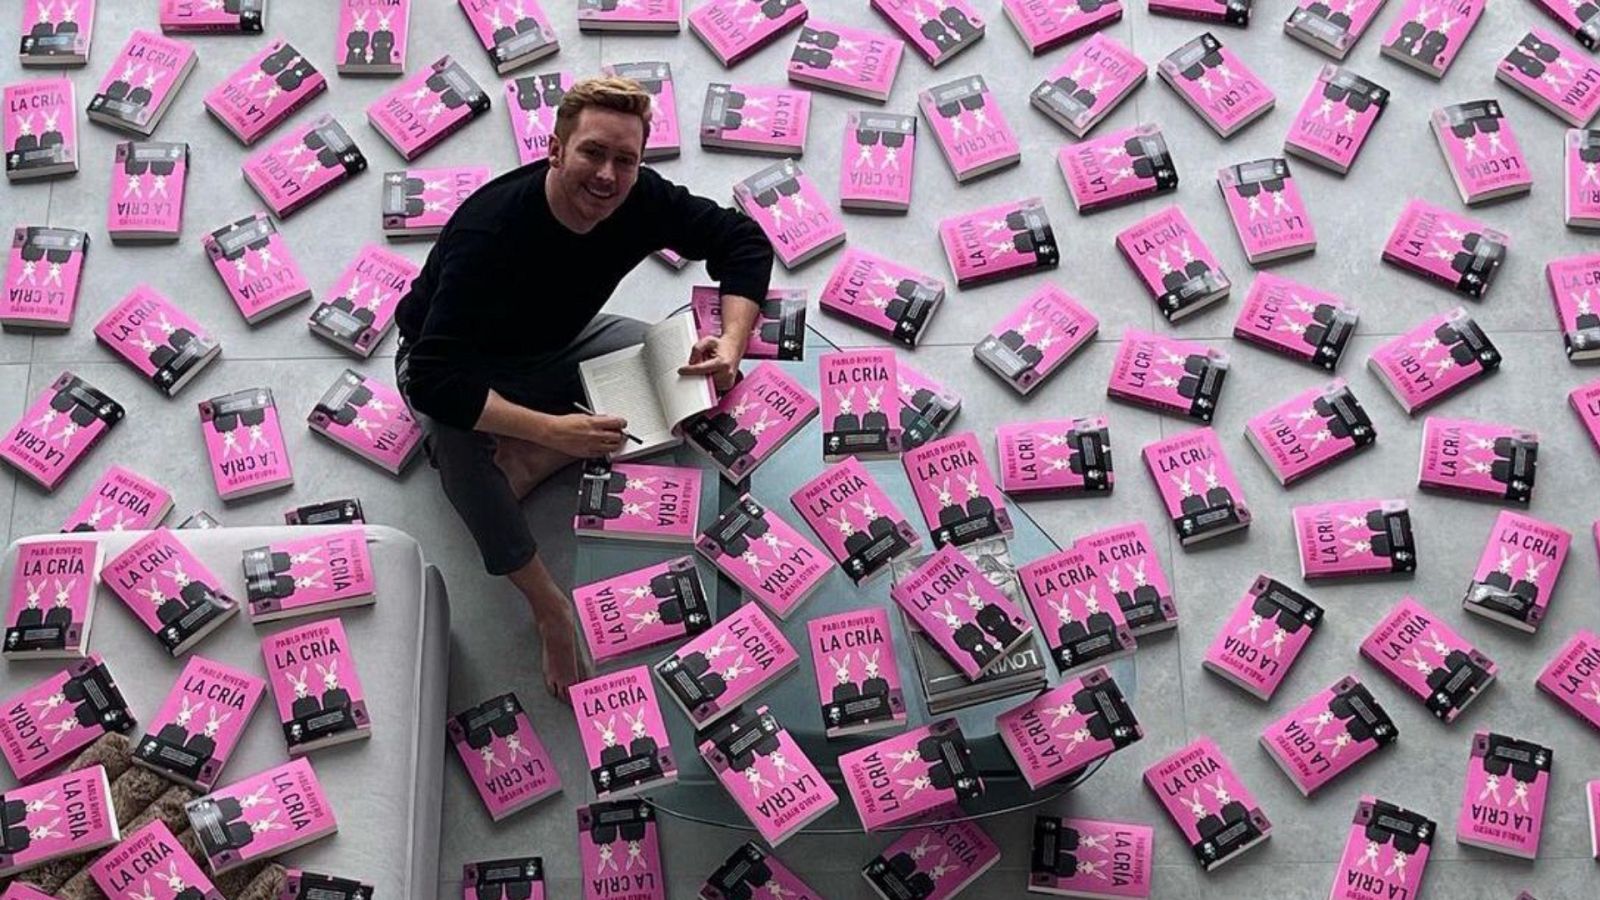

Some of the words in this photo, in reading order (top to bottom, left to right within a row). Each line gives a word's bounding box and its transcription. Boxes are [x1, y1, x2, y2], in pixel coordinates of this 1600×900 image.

[127, 44, 145, 59] LA
[11, 98, 28, 112] LA
[1335, 133, 1353, 150] LA
[282, 178, 301, 196] LA
[1090, 176, 1108, 194] LA
[1133, 239, 1155, 256] LA
[969, 250, 987, 268] LA
[839, 289, 859, 305] LA
[111, 325, 133, 342] LA
[1255, 315, 1275, 331] LA
[832, 358, 855, 366] PABLO
[857, 356, 883, 364] RIVERO
[828, 369, 848, 385] LA
[852, 363, 889, 383] CRÍA
[1128, 373, 1147, 388] LA
[765, 391, 797, 421] CRÍA
[14, 427, 46, 454] CRÍA
[917, 448, 940, 461] PABLO
[940, 440, 967, 453] RIVERO
[45, 447, 65, 466] LA
[917, 462, 940, 481] LA
[940, 448, 979, 472] CRÍA
[1158, 456, 1180, 473] LA
[1289, 444, 1309, 464] LA
[1021, 464, 1038, 481] LA
[1440, 461, 1457, 477] LA
[805, 482, 827, 499] PABLO
[826, 467, 850, 485] RIVERO
[99, 482, 119, 500] LA
[118, 492, 150, 517] CRÍA
[809, 498, 833, 517] LA
[830, 475, 868, 503] CRÍA
[657, 494, 679, 526] CRÍA
[30, 548, 54, 556] PABLO
[56, 547, 82, 555] RIVERO
[789, 546, 813, 566] LA
[1110, 539, 1147, 561] CRÍA
[1321, 546, 1339, 563] LA
[23, 560, 42, 576] LA
[47, 555, 83, 575] CRÍA
[800, 562, 820, 581] PABLO
[907, 574, 928, 594] PABLO
[926, 556, 950, 577] RIVERO
[1033, 563, 1057, 577] PABLO
[1057, 554, 1084, 568] RIVERO
[118, 570, 143, 590] LA
[760, 563, 796, 593] CRÍA
[780, 579, 802, 599] RIVERO
[912, 591, 937, 612] LA
[932, 564, 970, 595] CRÍA
[1034, 578, 1058, 597] LA
[1058, 563, 1098, 588] CRÍA
[584, 597, 598, 622] RIVERO
[594, 586, 621, 622] CRÍA
[592, 622, 606, 644] PABLO
[608, 623, 628, 644] LA
[748, 614, 767, 633] PABLO
[764, 632, 784, 654] RIVERO
[822, 621, 846, 632] PABLO
[847, 616, 875, 627] RIVERO
[1375, 627, 1393, 645] PABLO
[1390, 609, 1411, 629] RIVERO
[275, 635, 300, 648] PABLO
[301, 627, 330, 640] RIVERO
[727, 618, 750, 640] LA
[743, 636, 775, 670] CRÍA
[820, 635, 842, 653] LA
[845, 625, 884, 648] CRÍA
[1225, 634, 1258, 663] CRÍA
[1382, 642, 1405, 661] LA
[1397, 615, 1431, 644] CRÍA
[274, 650, 298, 669] LA
[300, 636, 341, 661] CRÍA
[1259, 655, 1280, 675] LA
[198, 665, 223, 679] PABLO
[222, 674, 249, 689] RIVERO
[584, 683, 608, 696] PABLO
[609, 675, 637, 689] RIVERO
[183, 675, 205, 695] LA
[207, 684, 245, 710] CRÍA
[583, 698, 606, 718] LA
[608, 684, 648, 710] CRÍA
[8, 702, 37, 739] CRÍA
[1020, 708, 1050, 746] CRÍA
[27, 736, 49, 760] LA
[1285, 720, 1315, 754] CRÍA
[522, 758, 545, 777] LA
[1041, 745, 1063, 768] LA
[1159, 761, 1181, 777] PABLO
[1180, 748, 1205, 765] RIVERO
[1310, 751, 1332, 773] LA
[861, 751, 890, 789] CRÍA
[1163, 776, 1187, 796] LA
[1184, 757, 1221, 784] CRÍA
[62, 779, 82, 801] LA
[271, 772, 294, 794] LA
[484, 769, 523, 794] CRÍA
[792, 773, 817, 794] LA
[295, 771, 312, 792] PABLO
[306, 792, 323, 817] RIVERO
[756, 788, 796, 817] CRÍA
[798, 792, 821, 810] PABLO
[878, 790, 900, 812] LA
[66, 802, 92, 840] CRÍA
[282, 793, 313, 830] CRÍA
[774, 807, 800, 826] RIVERO
[1472, 803, 1508, 827] CRÍA
[1474, 824, 1500, 837] RIVERO
[1514, 814, 1533, 832] LA
[1115, 830, 1132, 848] LA
[1502, 831, 1526, 843] PABLO
[109, 869, 136, 892] LA
[132, 841, 174, 874] CRÍA
[1111, 853, 1133, 886] CRÍA
[593, 876, 630, 898] CRÍA
[634, 872, 655, 890] LA
[1348, 868, 1384, 895] CRÍA
[1389, 883, 1408, 900] LA
